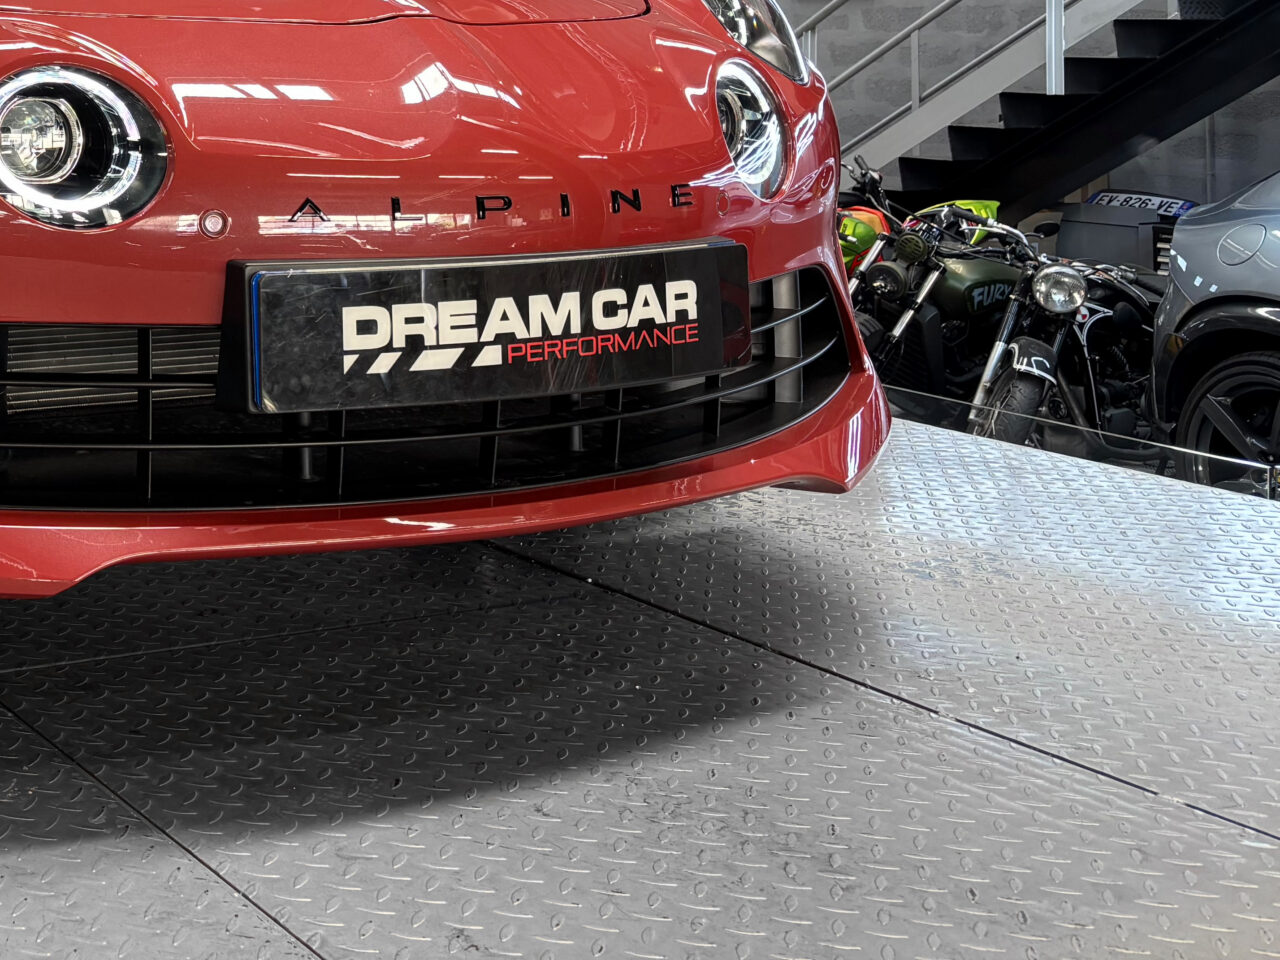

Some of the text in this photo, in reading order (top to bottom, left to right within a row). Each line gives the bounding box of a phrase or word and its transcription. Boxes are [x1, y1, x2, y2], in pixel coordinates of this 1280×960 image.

[289, 183, 694, 222] ALPINE
[342, 280, 698, 351] DREAM CAR
[972, 283, 1012, 311] FURY
[507, 323, 699, 364] PERFORMANCE
